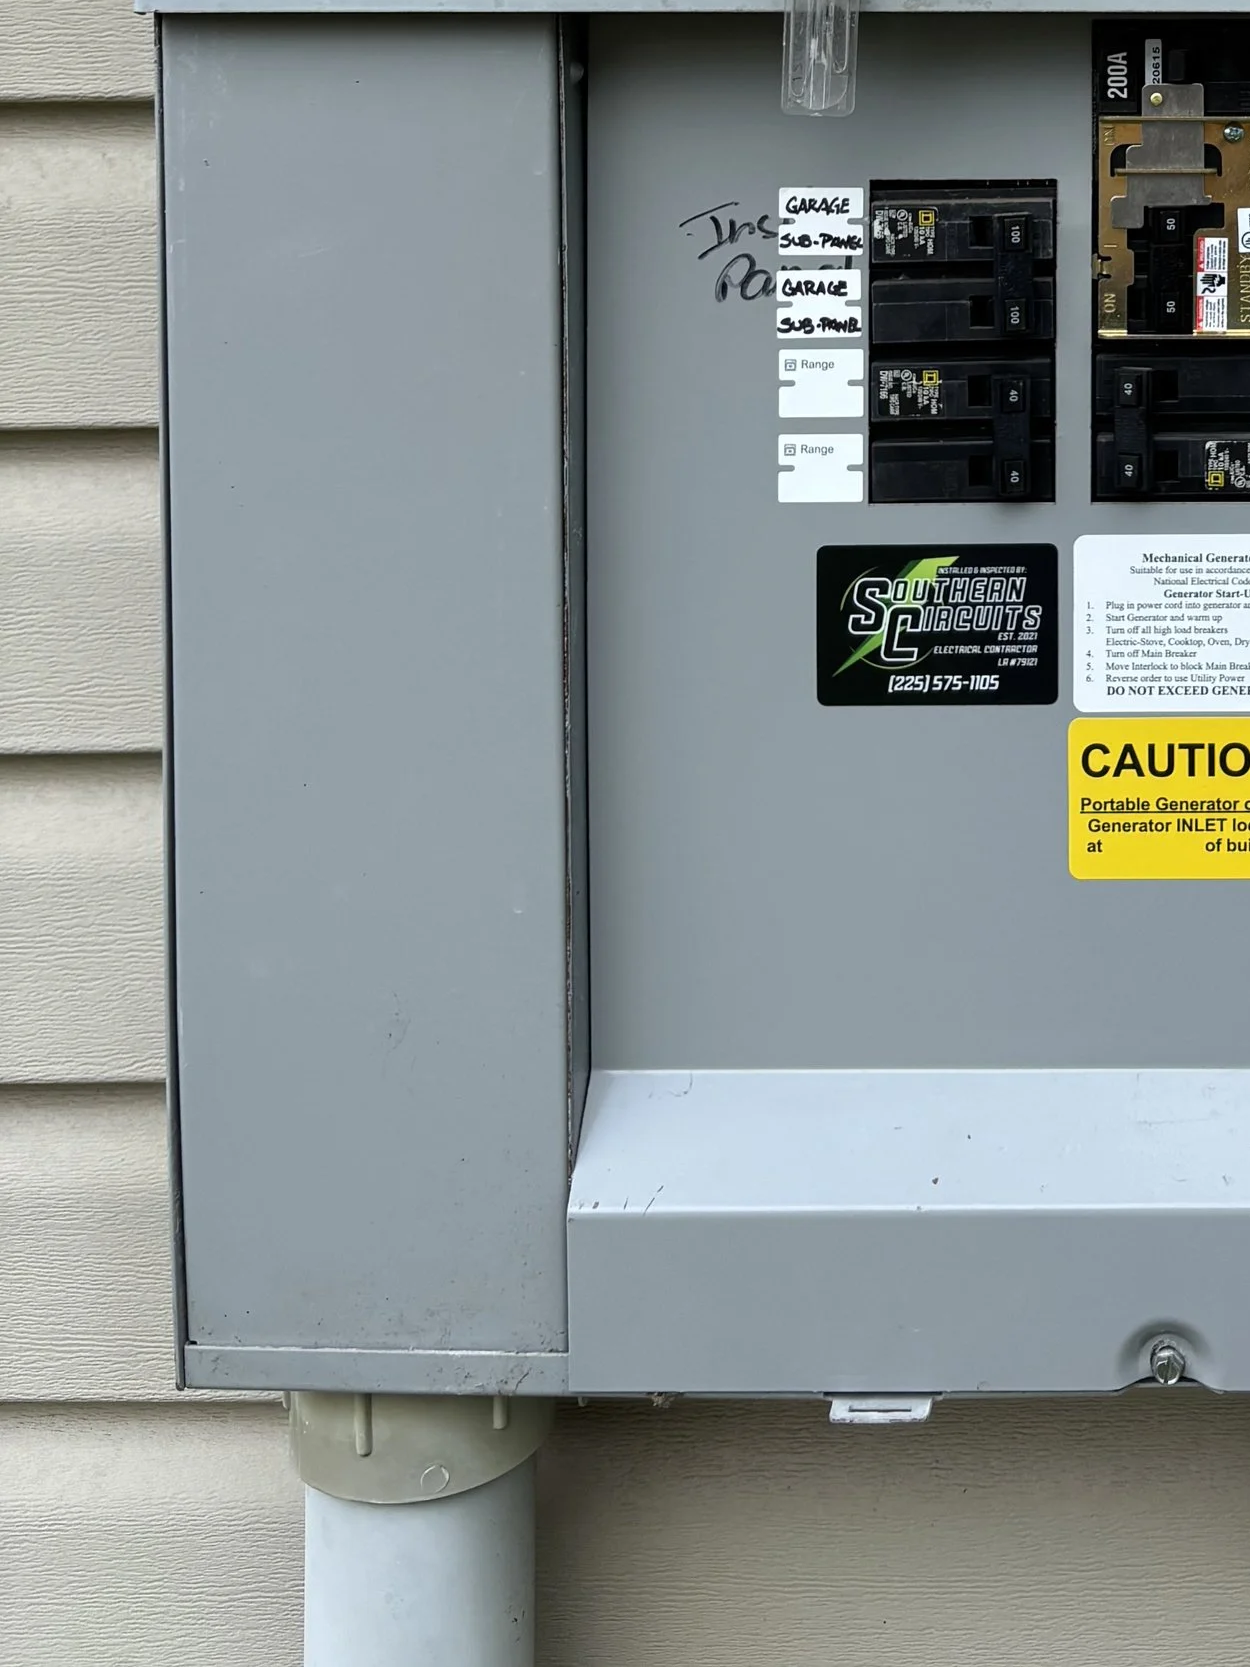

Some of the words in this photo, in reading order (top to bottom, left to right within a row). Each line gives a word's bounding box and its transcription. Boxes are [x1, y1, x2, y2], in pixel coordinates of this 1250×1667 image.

[1107, 52, 1128, 98] 200A
[786, 196, 849, 215] GARAGE
[1167, 218, 1175, 230] 50
[1010, 225, 1021, 244] 100
[782, 279, 848, 296] GARAGE
[1240, 254, 1250, 322] STANDBY
[1104, 293, 1116, 313] ON
[1167, 301, 1175, 313] 50
[1009, 305, 1019, 325] 100
[801, 360, 834, 370] Range
[1124, 383, 1133, 395] 40
[1008, 390, 1018, 402] 40
[801, 445, 834, 455] Range
[1010, 471, 1019, 482] 40
[1124, 465, 1133, 476] 40
[1142, 553, 1202, 563] Mechanical
[1164, 590, 1213, 598] Generator
[849, 577, 1026, 634] SOUTHERN
[881, 605, 1042, 662] CIRCUITS
[998, 633, 1015, 641] EST.
[1106, 638, 1166, 646] Electric-Stove,
[1168, 638, 1205, 647] Cooktop,
[1208, 638, 1232, 646] Oven,
[934, 645, 982, 653] ELECTRICAL
[984, 645, 1038, 653] CONTRACTOR
[932, 675, 999, 690] 575-1105
[1107, 686, 1125, 695] DO
[1128, 686, 1155, 695] NOT
[1158, 686, 1208, 695] EXCEED
[1080, 797, 1150, 811] Portable
[1155, 797, 1239, 811] Generator
[1088, 819, 1172, 832] Generator
[1177, 819, 1227, 831] INLET
[1087, 840, 1102, 853] at
[1205, 839, 1222, 852] of
